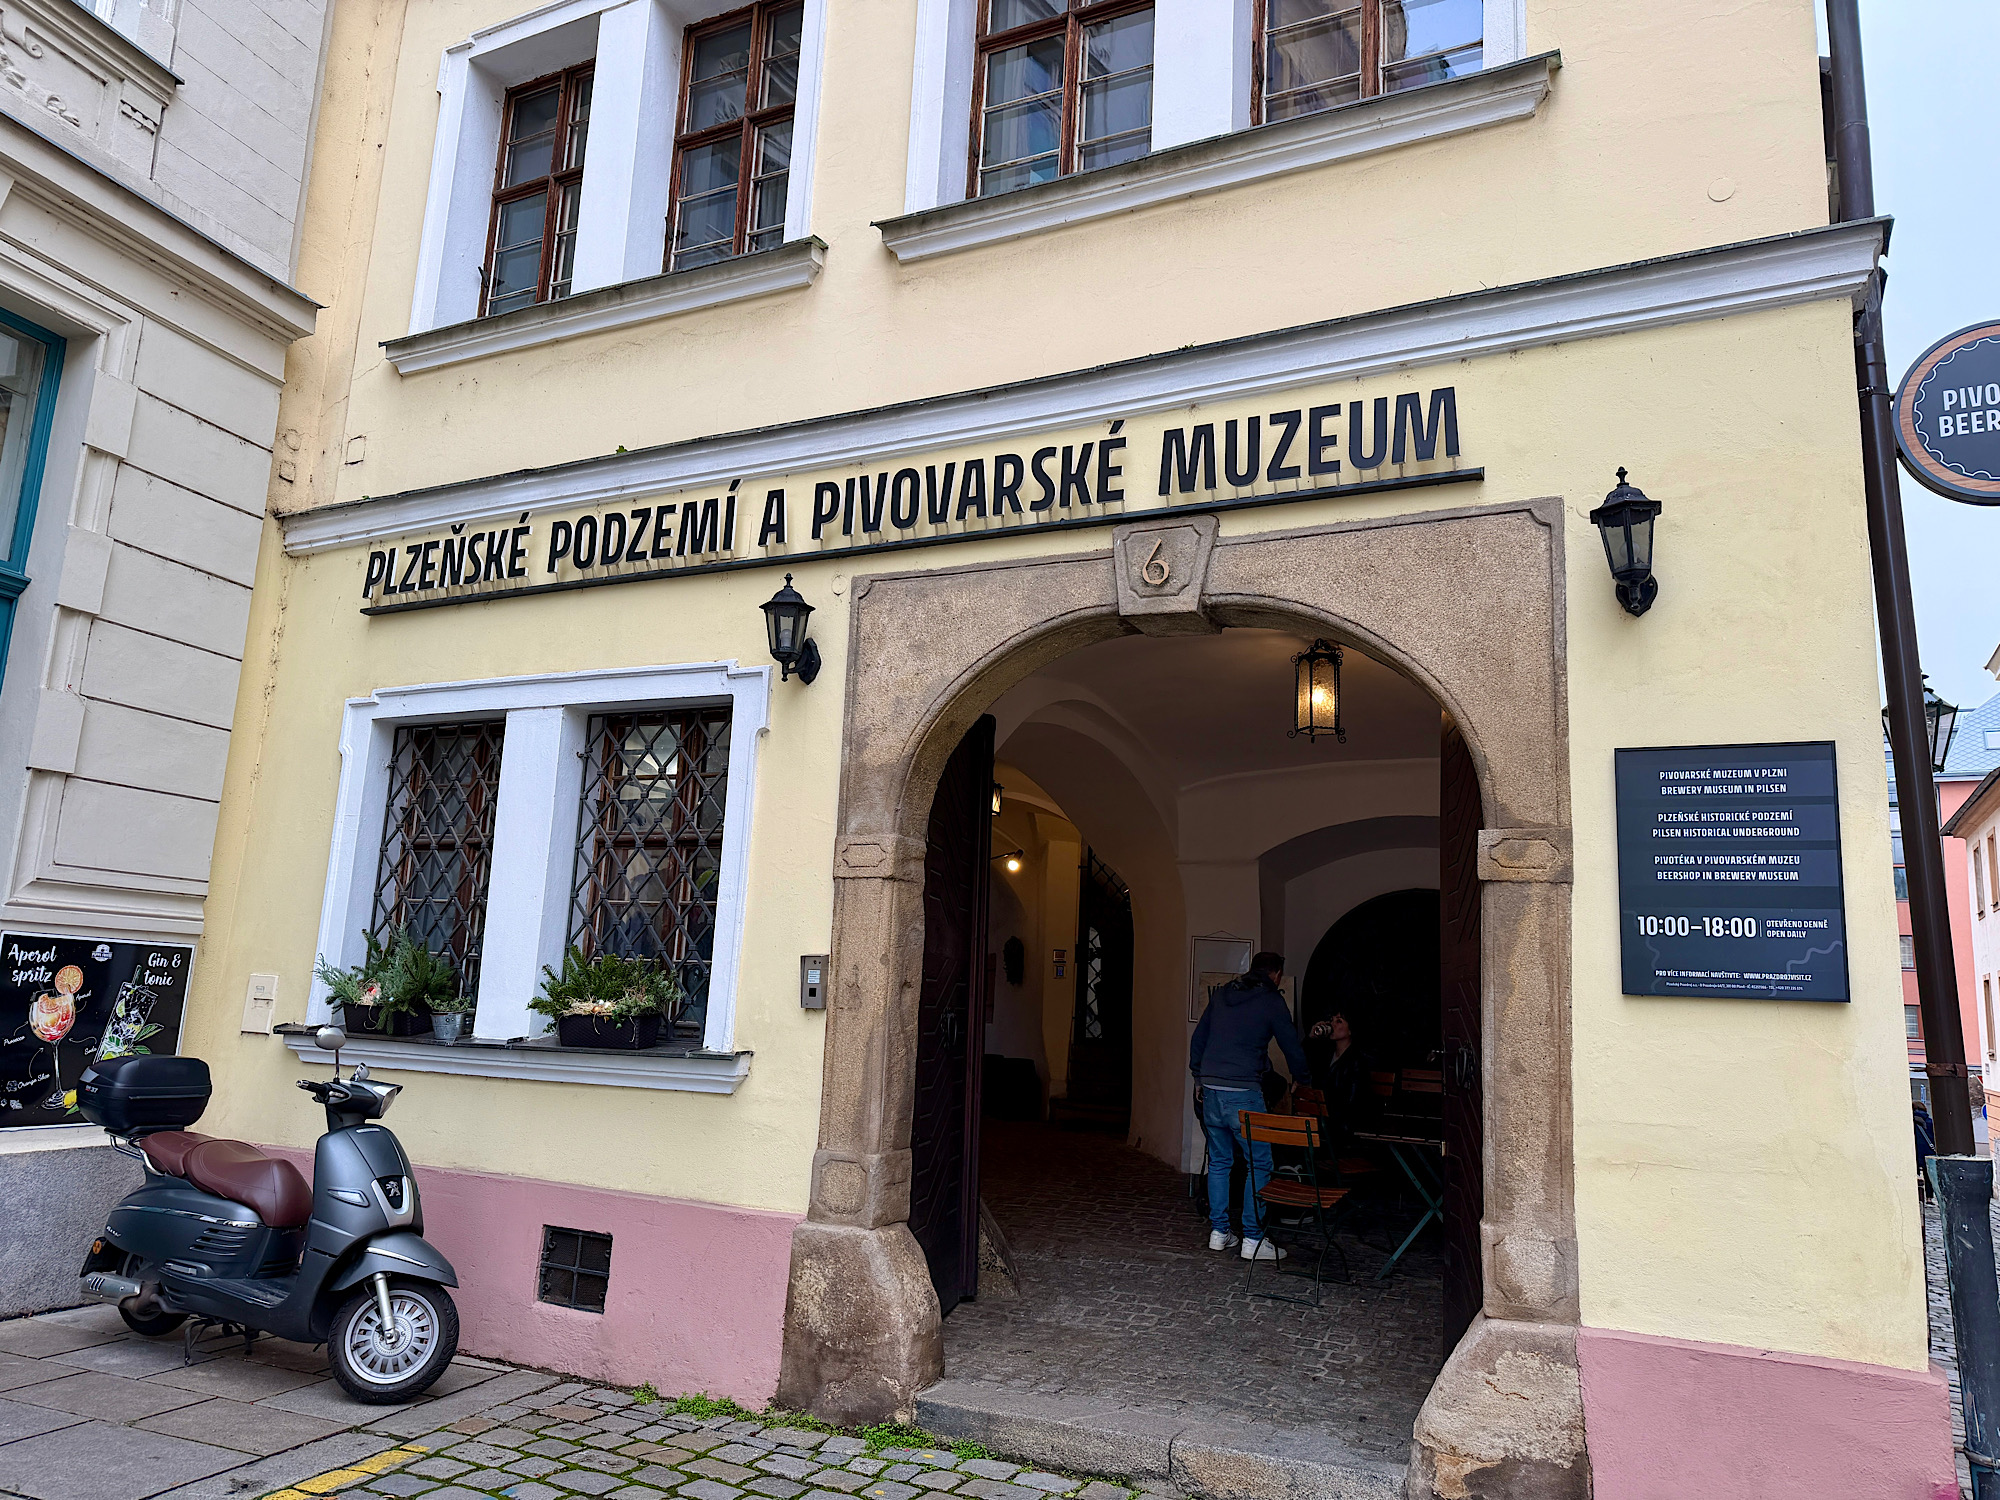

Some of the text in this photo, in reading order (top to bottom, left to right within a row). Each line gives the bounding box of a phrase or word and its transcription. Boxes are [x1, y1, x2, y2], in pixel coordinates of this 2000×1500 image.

[1943, 383, 2000, 411] PIVO
[1939, 409, 2000, 438] BEER
[362, 386, 1461, 599] PLZEŇSKÉ PODZEMÍ A PIVOVARSKÉ MUZEUM
[1141, 537, 1171, 586] 6
[1659, 768, 1787, 780] PIVOVARSKÉ MUZEUM V PLZNI
[1661, 783, 1787, 795] BREWERY MUSEUM IN PILSEN
[1657, 809, 1793, 822] PLZEŇSKÉ HISTORICKÉ PODZEMÍ
[1652, 827, 1800, 837] PILSEN HISTORICAL UNDERGROUND
[1654, 853, 1801, 865] PIVOTÉKA V PIVOVARSKÉM MUZEU
[1657, 871, 1799, 880] BEERSHOP IN BREWERY MUSEUM
[1765, 918, 1829, 928] OTEVŘENO DENNĚ
[1765, 930, 1807, 938] OPEN DAILY
[7, 943, 57, 966] Aperol
[148, 952, 182, 968] Gin &
[11, 965, 53, 987] spritz
[143, 969, 175, 986] tonic
[1655, 969, 1667, 977] PRO
[1667, 969, 1679, 977] VÍCE
[1679, 970, 1710, 978] INFORMACÍ
